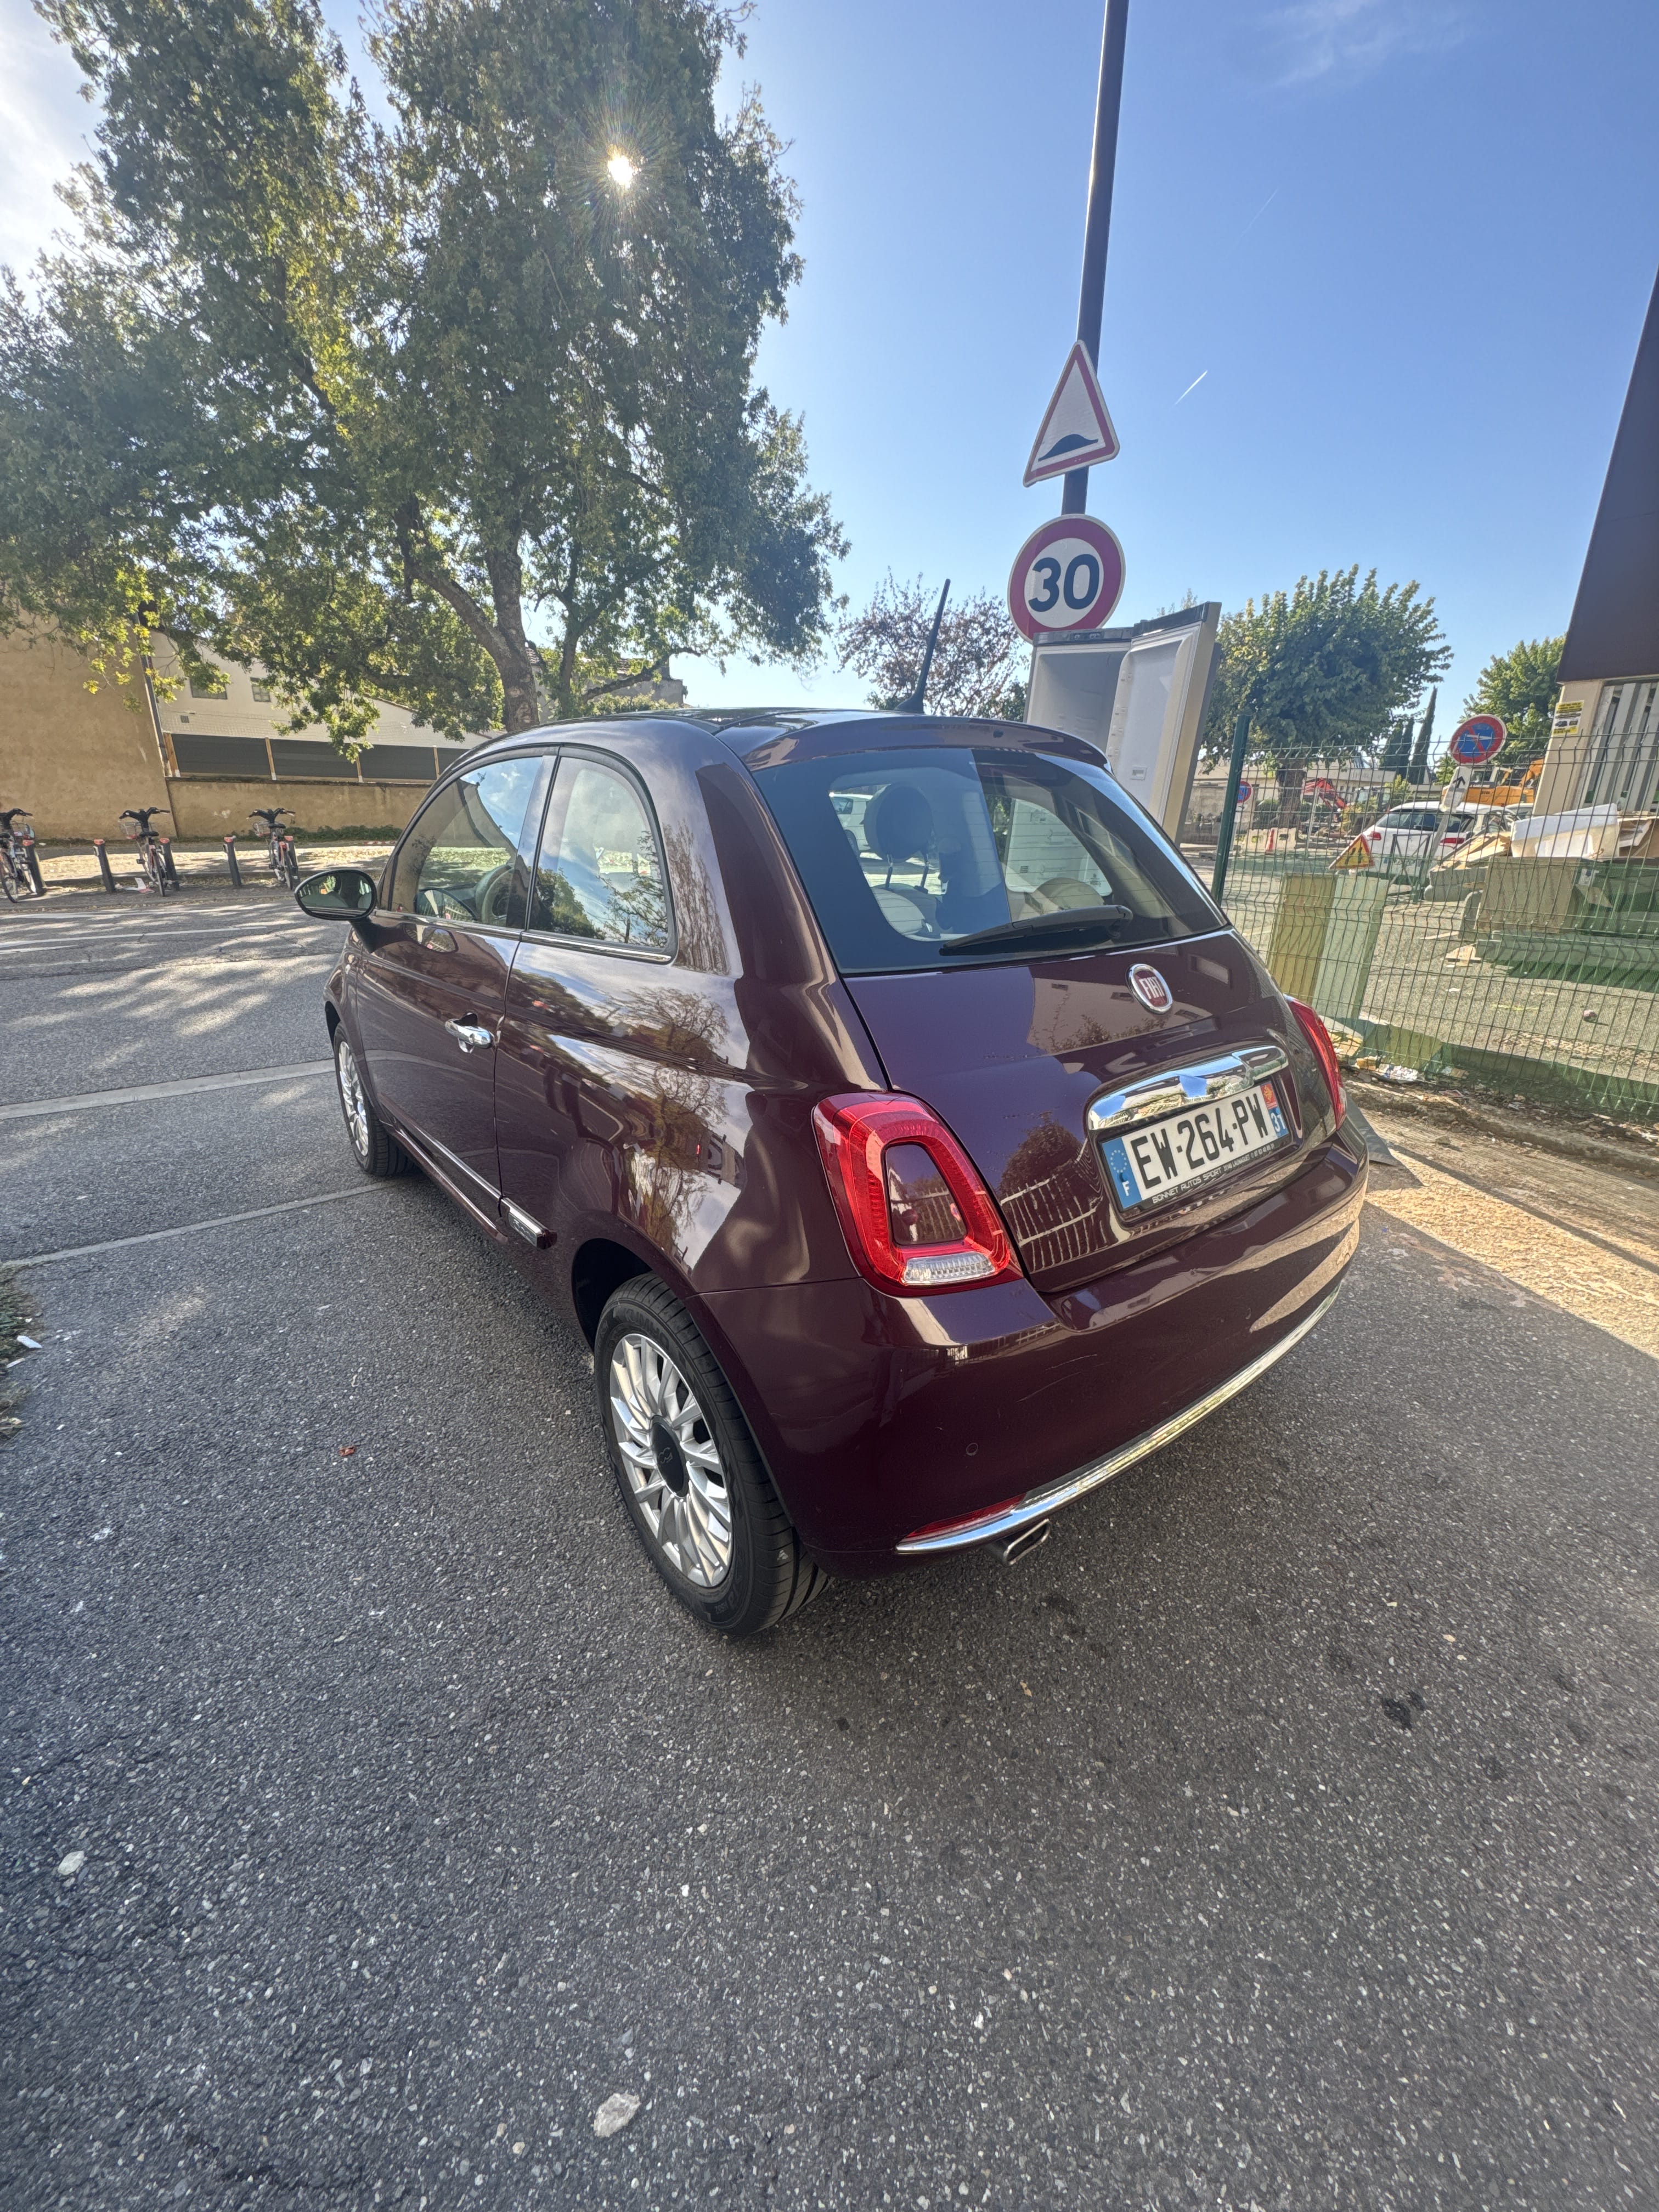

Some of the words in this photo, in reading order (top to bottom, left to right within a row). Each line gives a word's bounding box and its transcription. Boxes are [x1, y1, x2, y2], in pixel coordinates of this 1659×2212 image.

[1028, 554, 1100, 613] 30
[1138, 977, 1165, 1000] FIAT
[1271, 1112, 1285, 1132] 31
[1122, 1180, 1130, 1197] F
[1152, 1186, 1178, 1204] BONNET
[1180, 1177, 1202, 1191] AUTOS
[1203, 1167, 1221, 1181] SPORT
